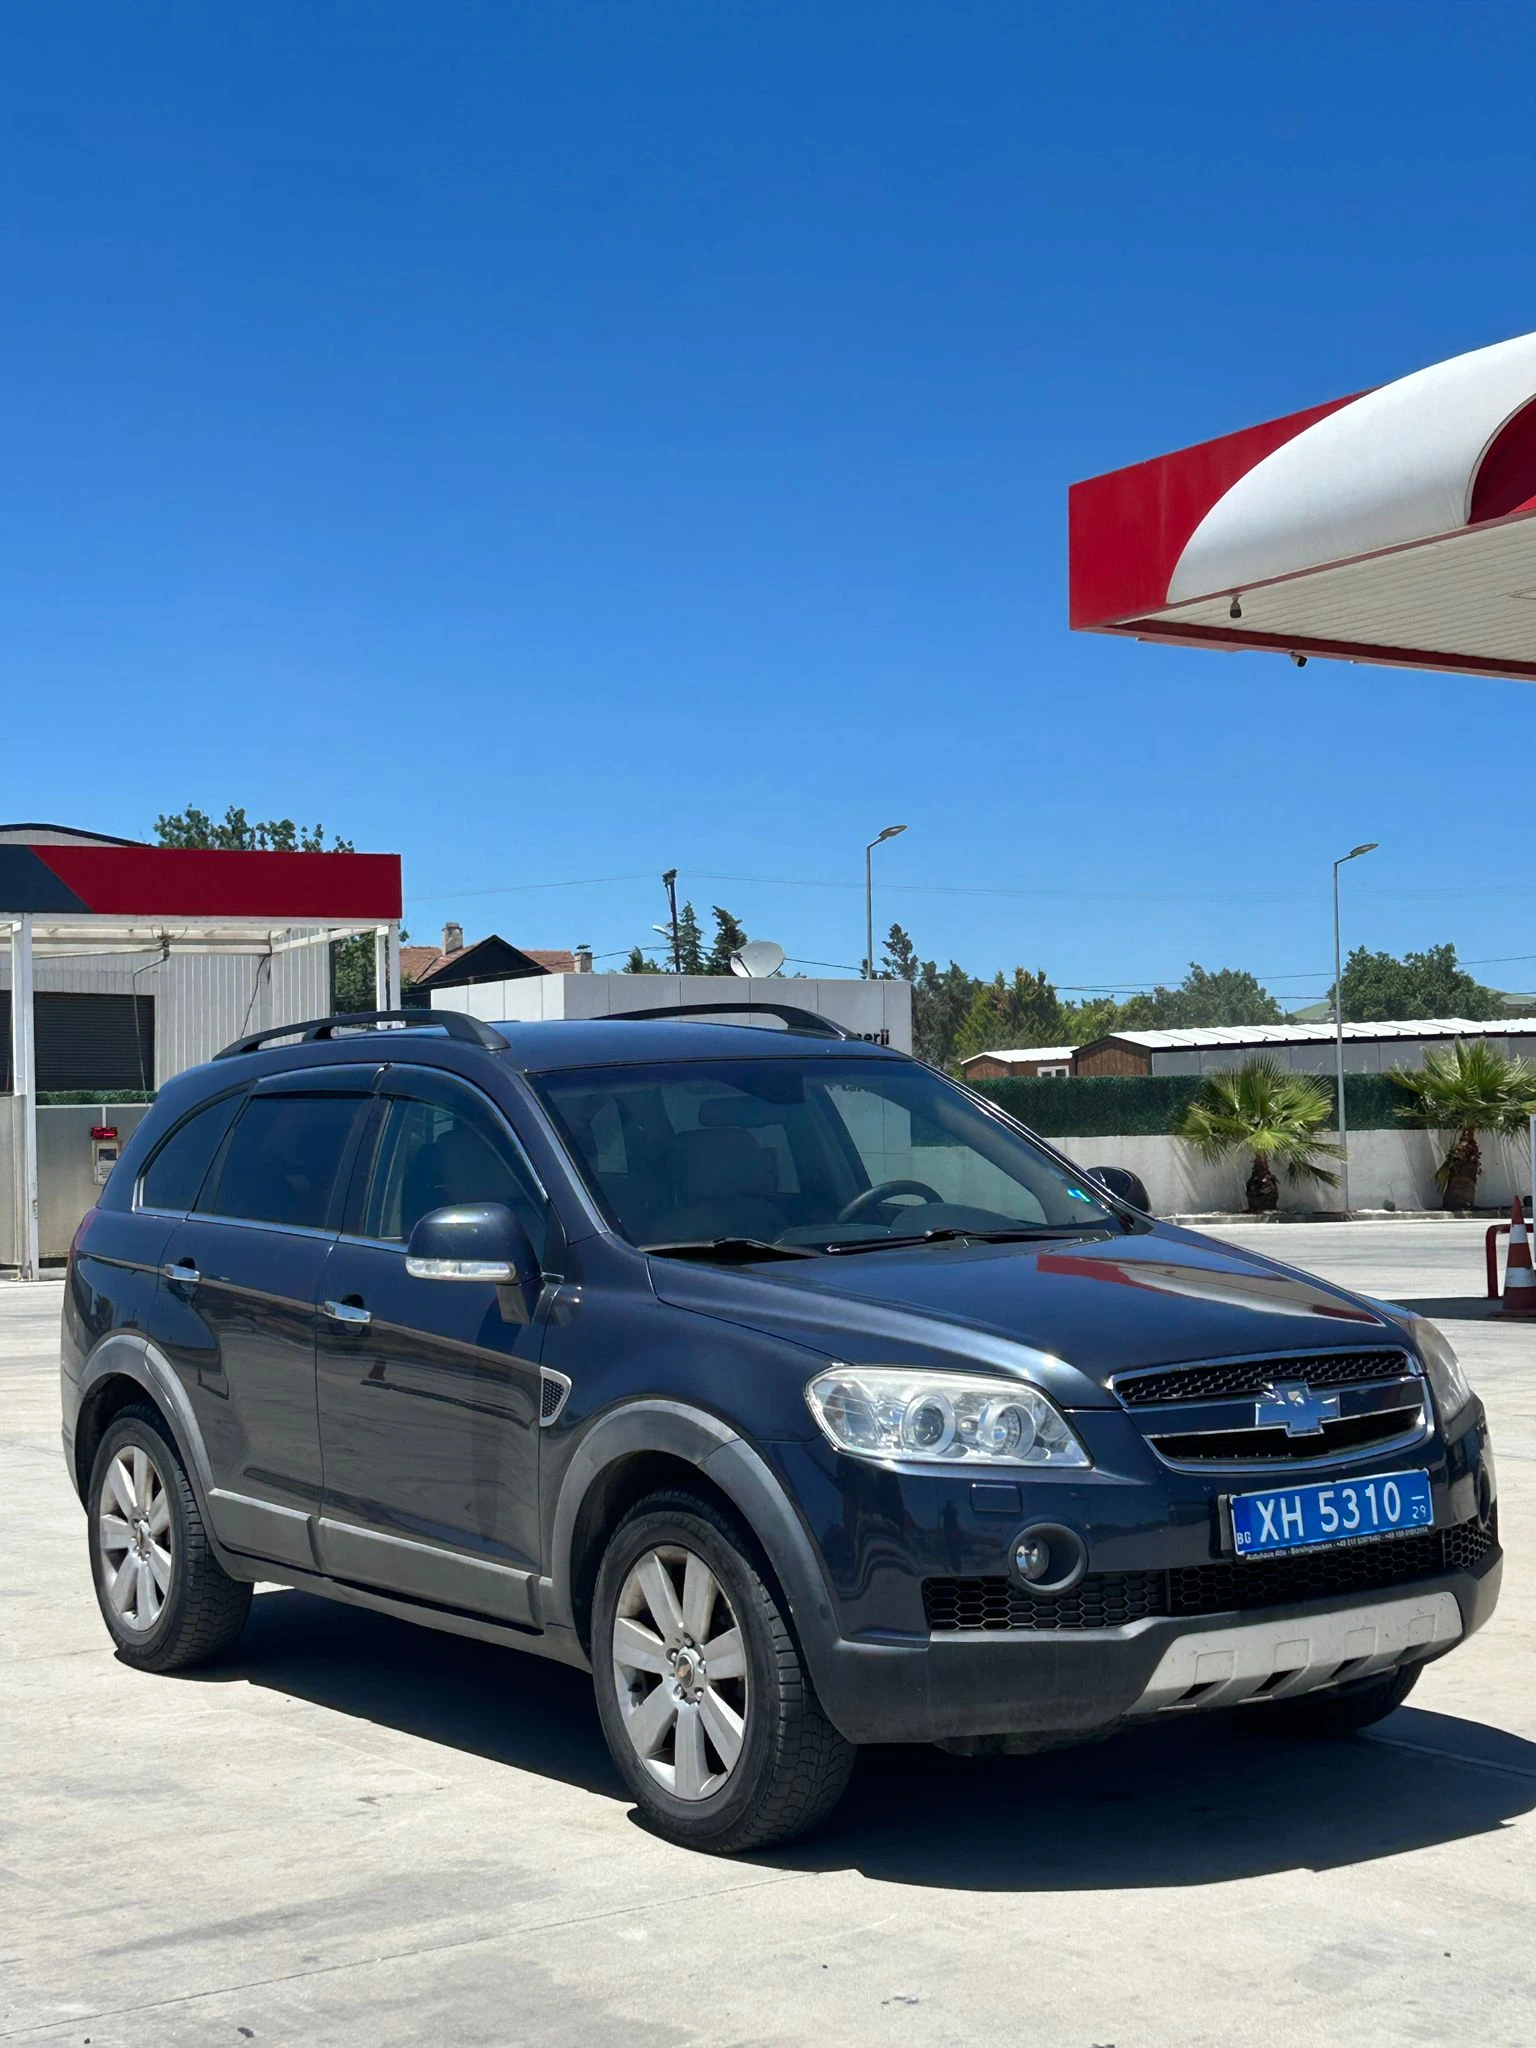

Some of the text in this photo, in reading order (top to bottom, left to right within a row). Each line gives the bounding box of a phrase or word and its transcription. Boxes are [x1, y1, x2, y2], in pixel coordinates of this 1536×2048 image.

[1255, 1481, 1401, 1543] XH 5310
[1236, 1531, 1252, 1545] BG
